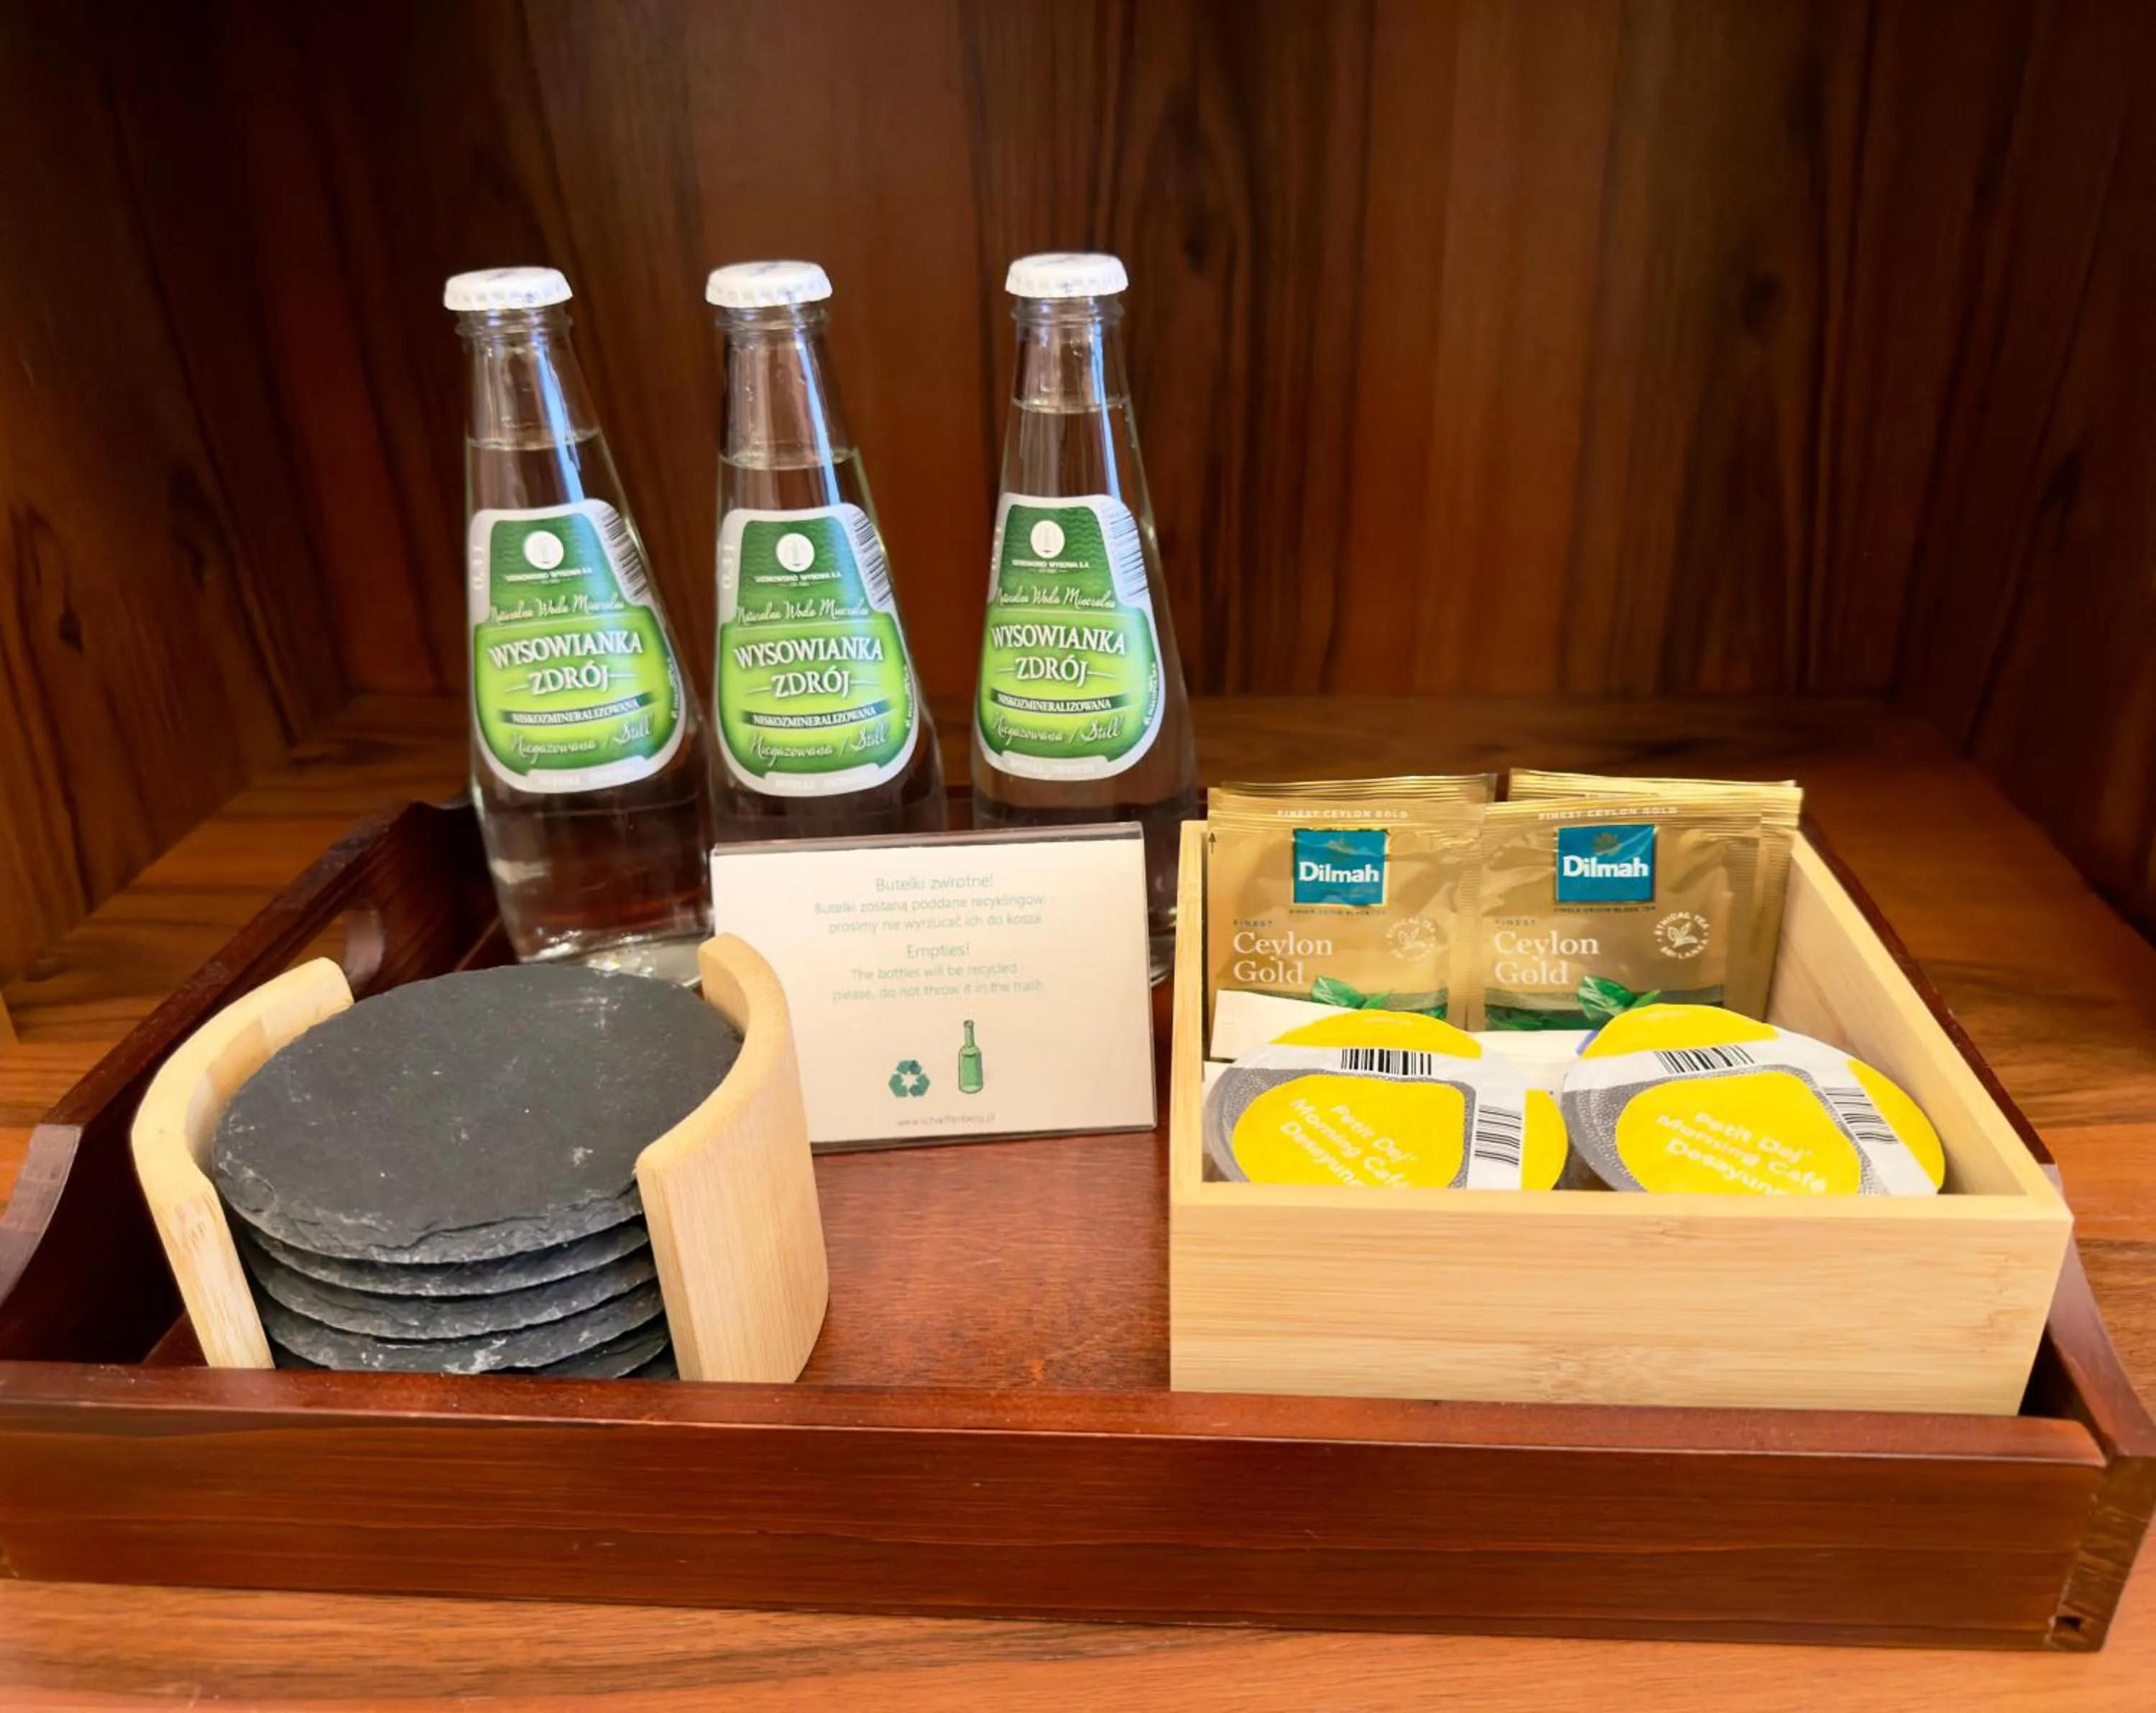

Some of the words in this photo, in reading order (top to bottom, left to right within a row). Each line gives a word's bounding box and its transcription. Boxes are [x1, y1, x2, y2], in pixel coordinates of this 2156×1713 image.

[489, 631, 643, 670] WYSOWIANKA
[733, 637, 885, 670] WYSOWIANKA
[991, 624, 1127, 656] WYSOWIANKA
[527, 660, 609, 696] ZDRÓJ
[771, 669, 850, 699] ZDRÓJ
[1015, 654, 1088, 688] ZDRÓJ
[1080, 715, 1125, 742] Still
[1322, 809, 1371, 818] CEYLON
[1375, 810, 1409, 819] GOLD
[1586, 808, 1638, 818] CEYLON
[1641, 806, 1678, 815] GOLD
[1299, 861, 1380, 883] Dilmah
[1562, 854, 1650, 878] Dilmah
[875, 875, 926, 892] Butelki
[930, 872, 994, 890] zwrotne!
[911, 897, 968, 912] poddane
[829, 920, 878, 934] prosimy
[882, 919, 901, 931] nie
[903, 915, 963, 932] wyrzucać
[965, 914, 984, 927] ich
[987, 914, 1004, 926] do
[906, 942, 970, 961] Empties!
[1233, 931, 1332, 961] Ceylon
[1493, 931, 1601, 961] Ceylon
[850, 966, 875, 982] The
[877, 967, 920, 980] bottles
[924, 964, 944, 978] will
[948, 964, 964, 976] be
[967, 961, 1018, 977] recycled
[1233, 961, 1304, 985] Gold
[1494, 961, 1570, 986] Gold
[878, 987, 896, 999] do
[899, 986, 921, 998] not
[923, 982, 960, 997] throw
[990, 981, 1010, 993] the
[1289, 1098, 1363, 1159] Morning
[1329, 1104, 1376, 1138] Petit
[1694, 1111, 1753, 1143] Petit
[1655, 1114, 1761, 1167] Morning
[1767, 1159, 1828, 1193] Café
